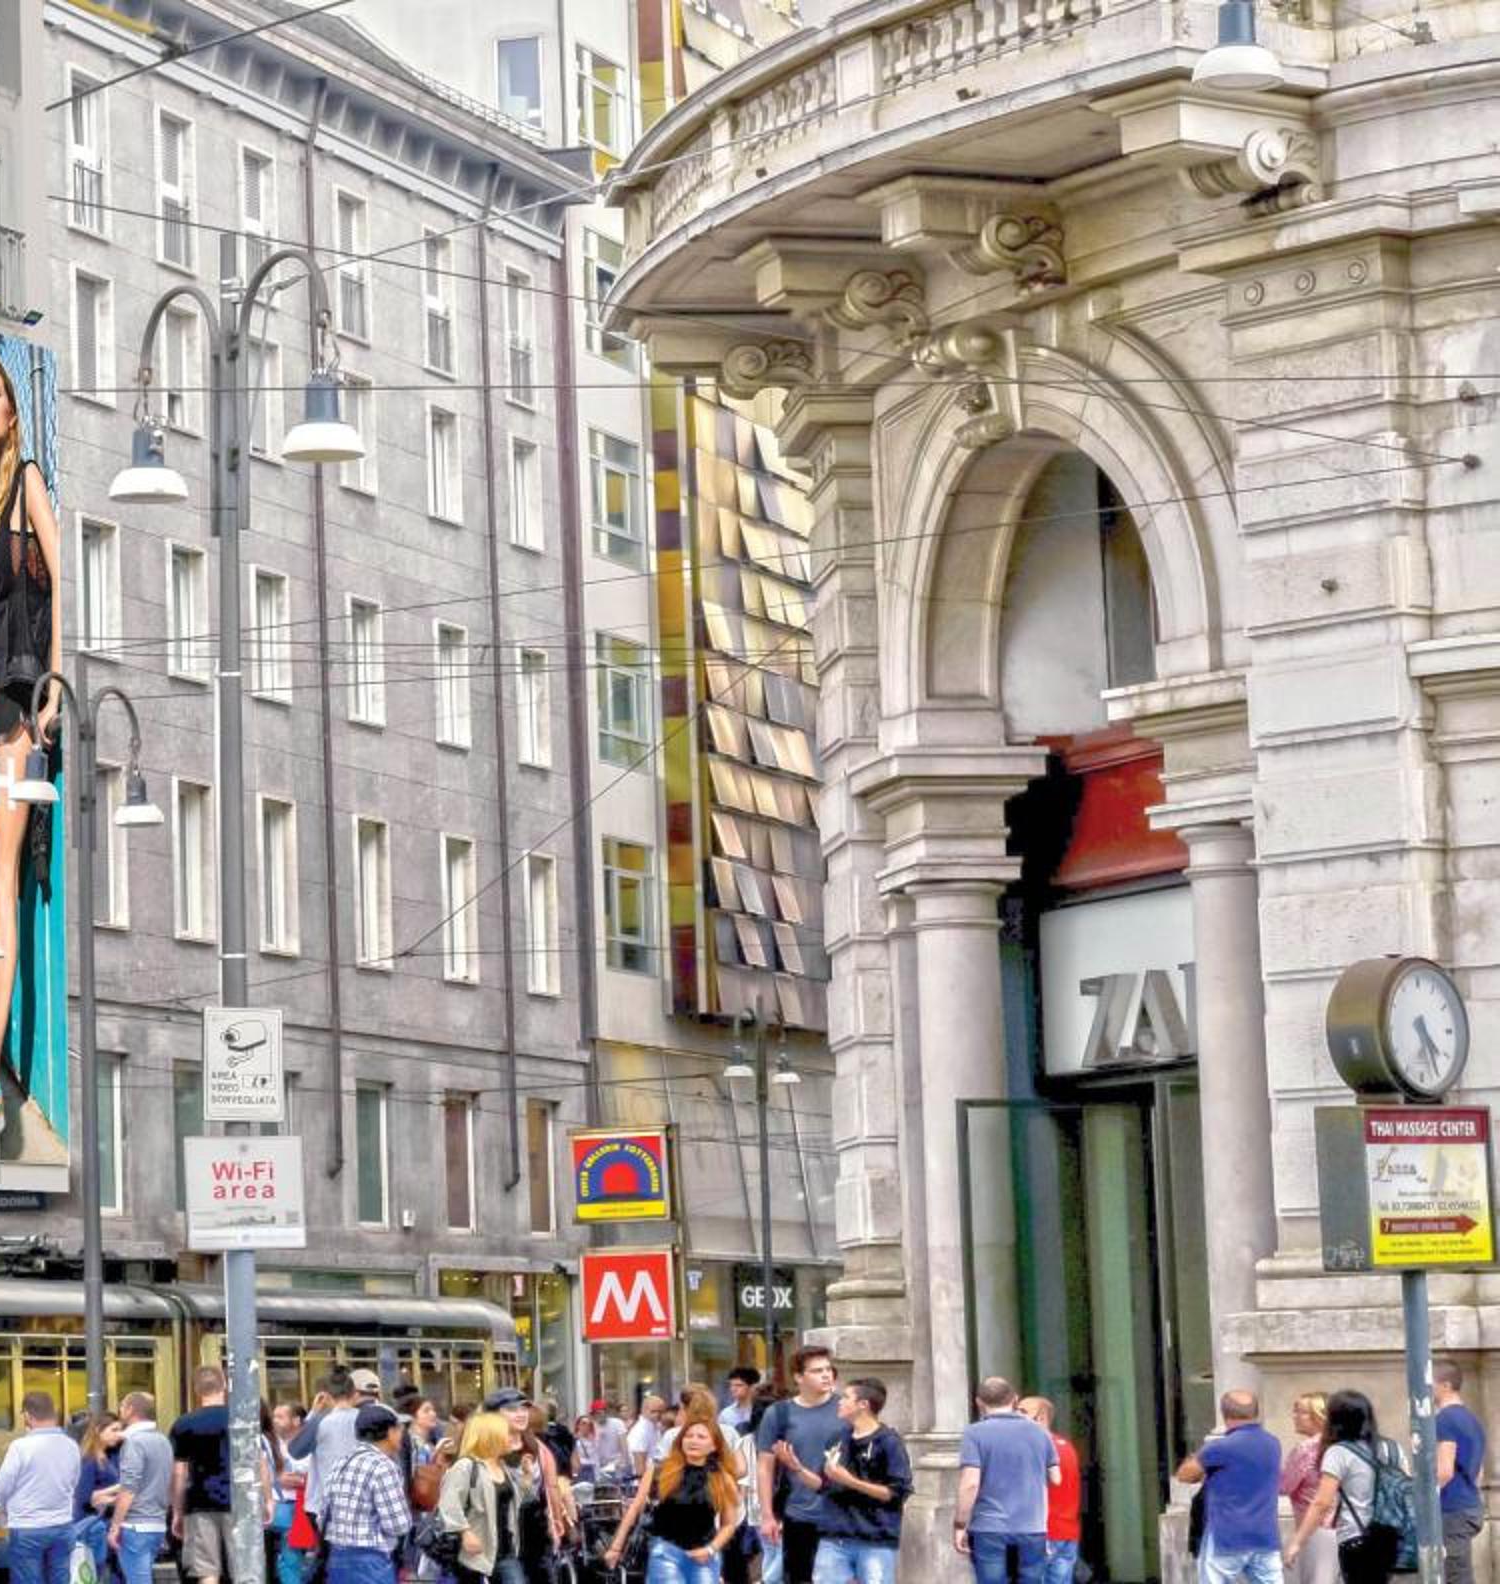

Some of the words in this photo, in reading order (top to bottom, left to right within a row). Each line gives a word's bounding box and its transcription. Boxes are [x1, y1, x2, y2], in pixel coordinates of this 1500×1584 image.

[1370, 1120, 1394, 1137] THAI
[1396, 1120, 1439, 1137] MASSAGE
[1441, 1120, 1477, 1137] CENTER
[212, 1160, 275, 1181] Wi-Fi
[213, 1183, 276, 1200] area
